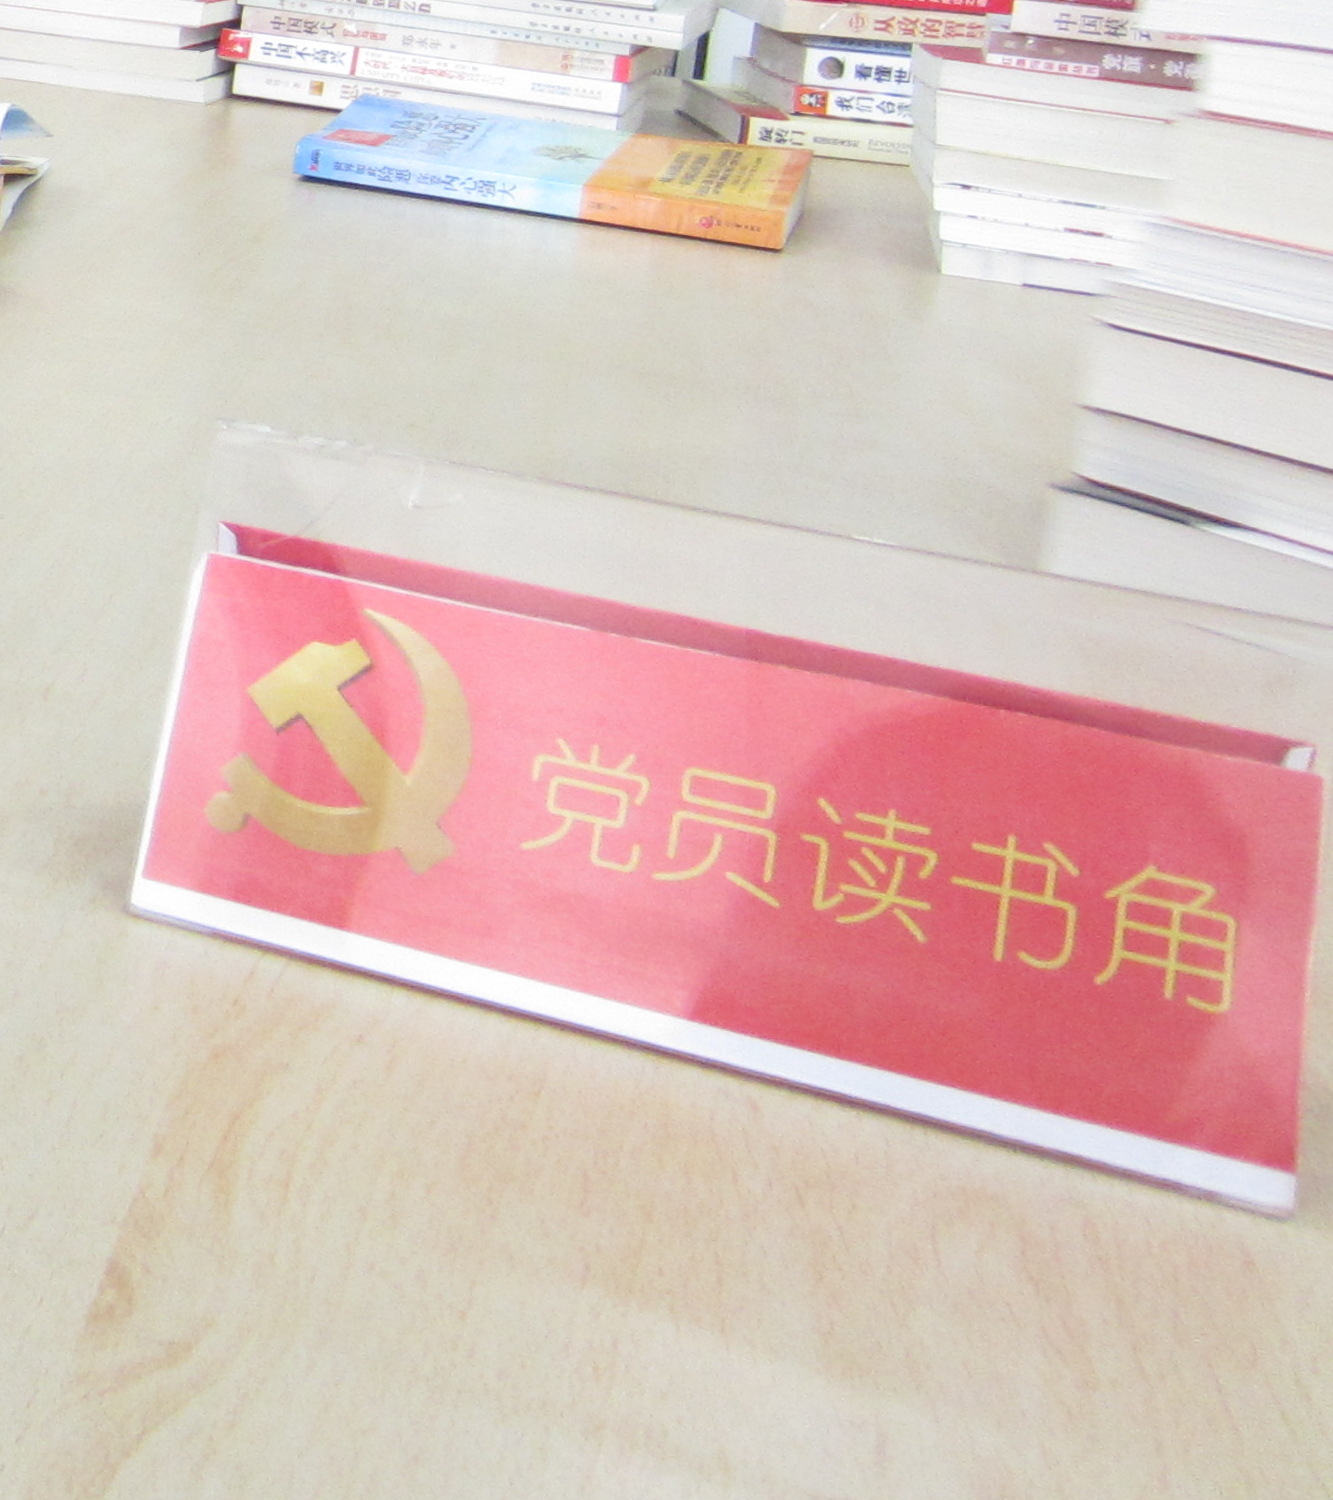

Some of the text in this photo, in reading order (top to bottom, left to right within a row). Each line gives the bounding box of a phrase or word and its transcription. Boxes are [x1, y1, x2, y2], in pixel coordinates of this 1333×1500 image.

[269, 15, 337, 39] 中国模式
[873, 16, 986, 40] 从政的智慧
[260, 41, 347, 66] 中国不高兴
[758, 125, 806, 147] 旋转门
[521, 735, 1240, 1016] 党员读书角
